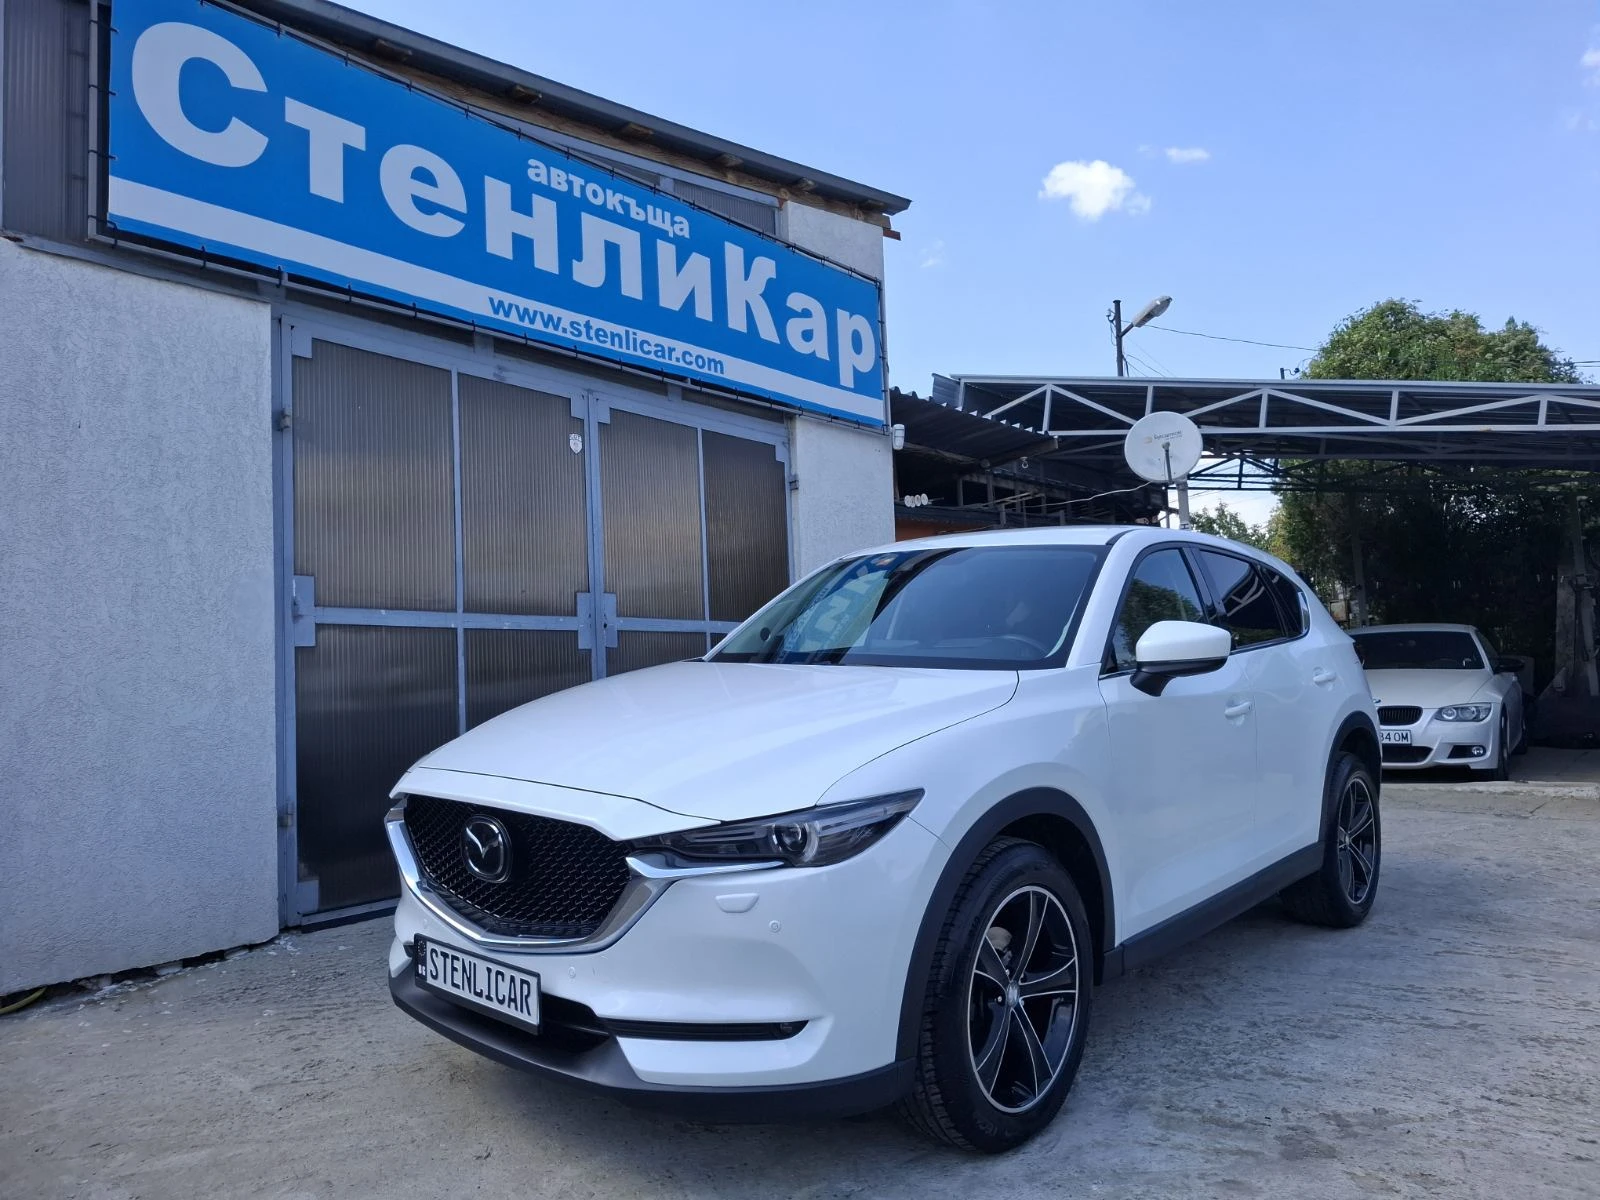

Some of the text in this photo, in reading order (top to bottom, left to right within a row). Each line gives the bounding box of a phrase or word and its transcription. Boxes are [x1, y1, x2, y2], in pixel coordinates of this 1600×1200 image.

[132, 22, 875, 388] СтенлиКар
[527, 158, 690, 239] автокъща
[488, 296, 725, 375] www.stenlicar.com
[429, 947, 532, 1017] STENLICAR
